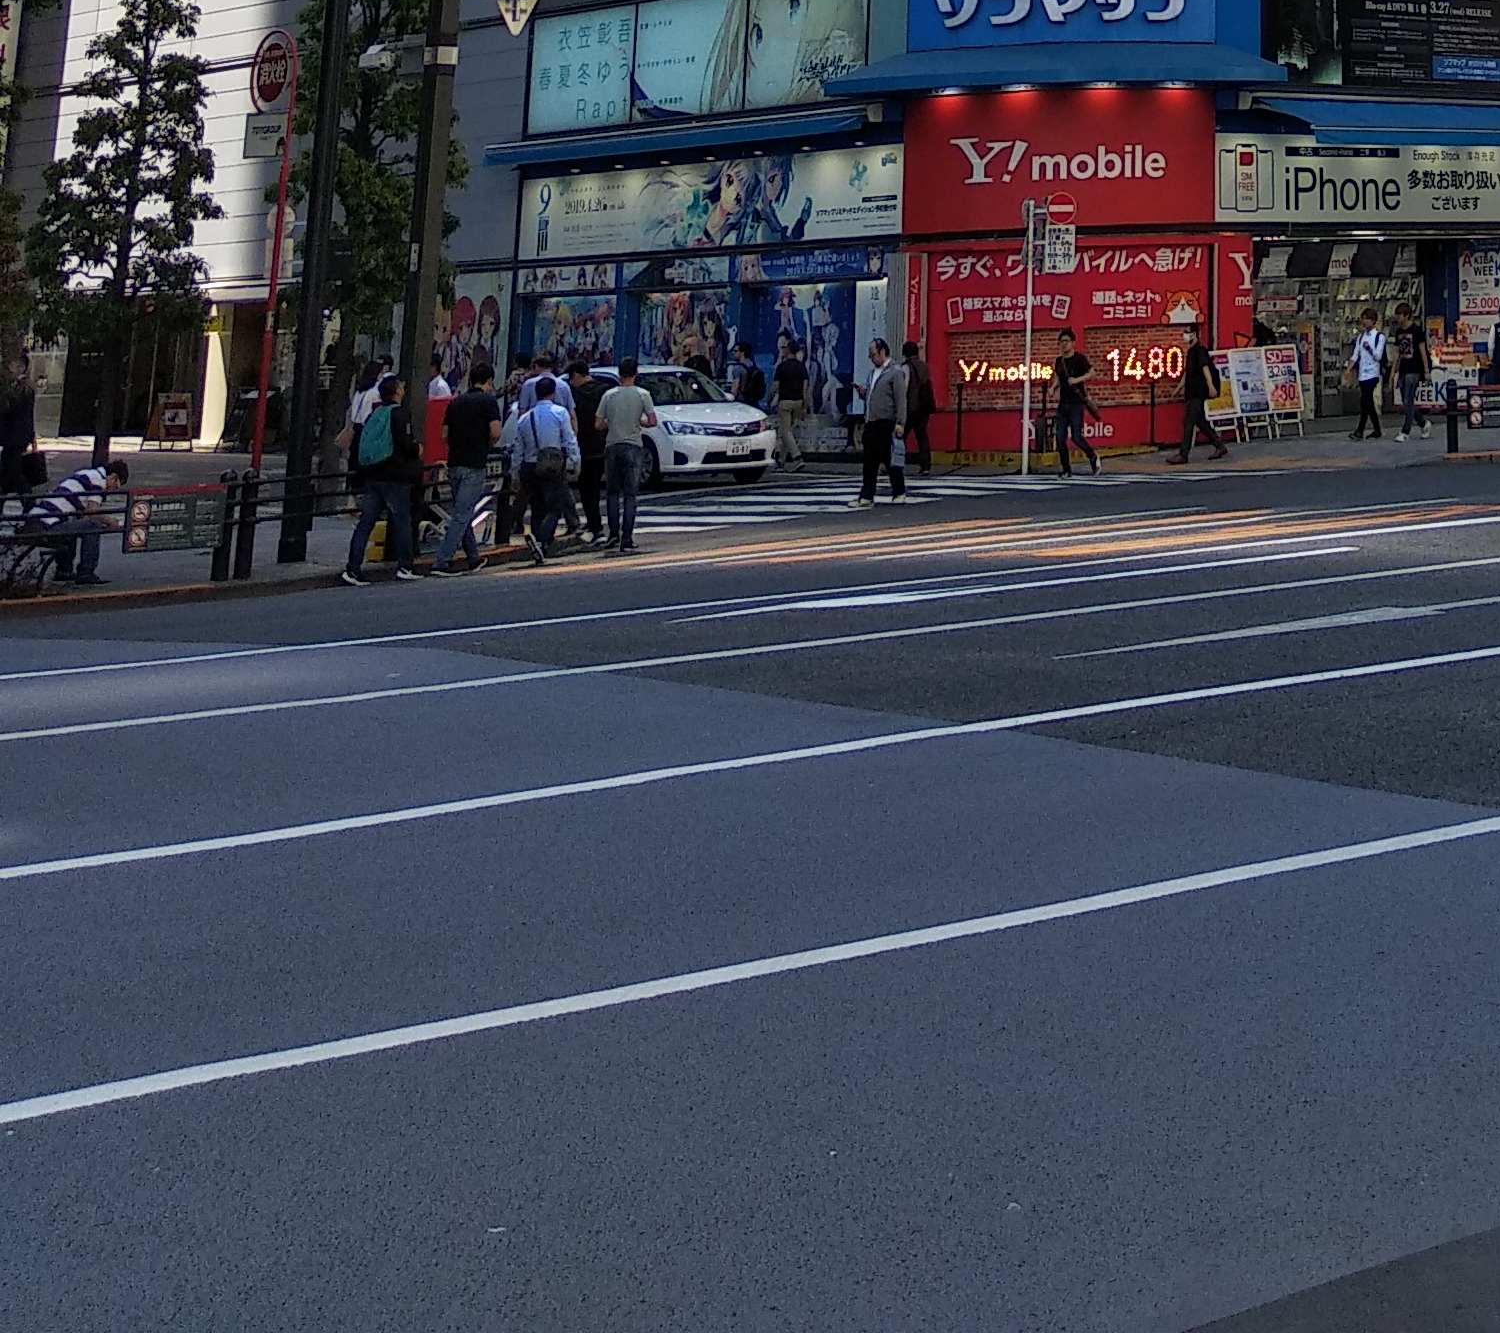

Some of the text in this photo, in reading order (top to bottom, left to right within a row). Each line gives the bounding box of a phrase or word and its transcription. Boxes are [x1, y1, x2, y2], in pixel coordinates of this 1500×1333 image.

[558, 18, 632, 52] 衣笠彰吾
[259, 58, 287, 86] 消火栓
[539, 48, 630, 91] 春夏冬ゆう
[1285, 166, 1401, 211] iPhone
[1432, 196, 1481, 211] ございます
[936, 245, 1203, 282] 今すぐ、ワバイルへ急げ!
[963, 294, 1052, 310] 格安スマホ・SMを
[1103, 305, 1152, 320] コミコミ!
[1106, 346, 1184, 382] 1480
[1267, 350, 1282, 363] SD
